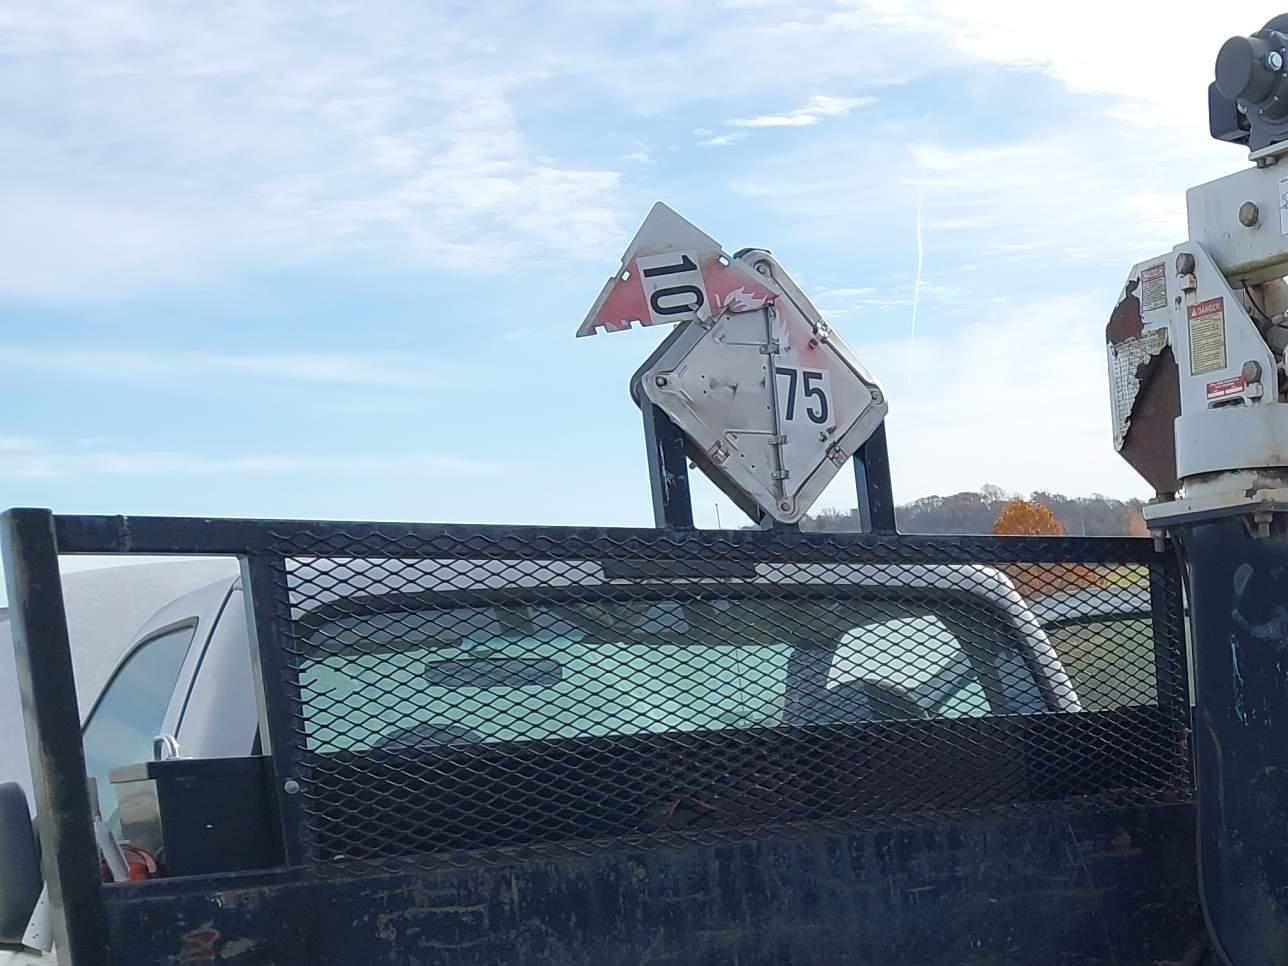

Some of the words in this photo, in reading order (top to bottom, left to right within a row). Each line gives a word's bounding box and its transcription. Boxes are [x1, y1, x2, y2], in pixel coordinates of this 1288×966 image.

[643, 254, 706, 316] 10
[1197, 303, 1222, 316] DANGER
[775, 367, 829, 424] 75
